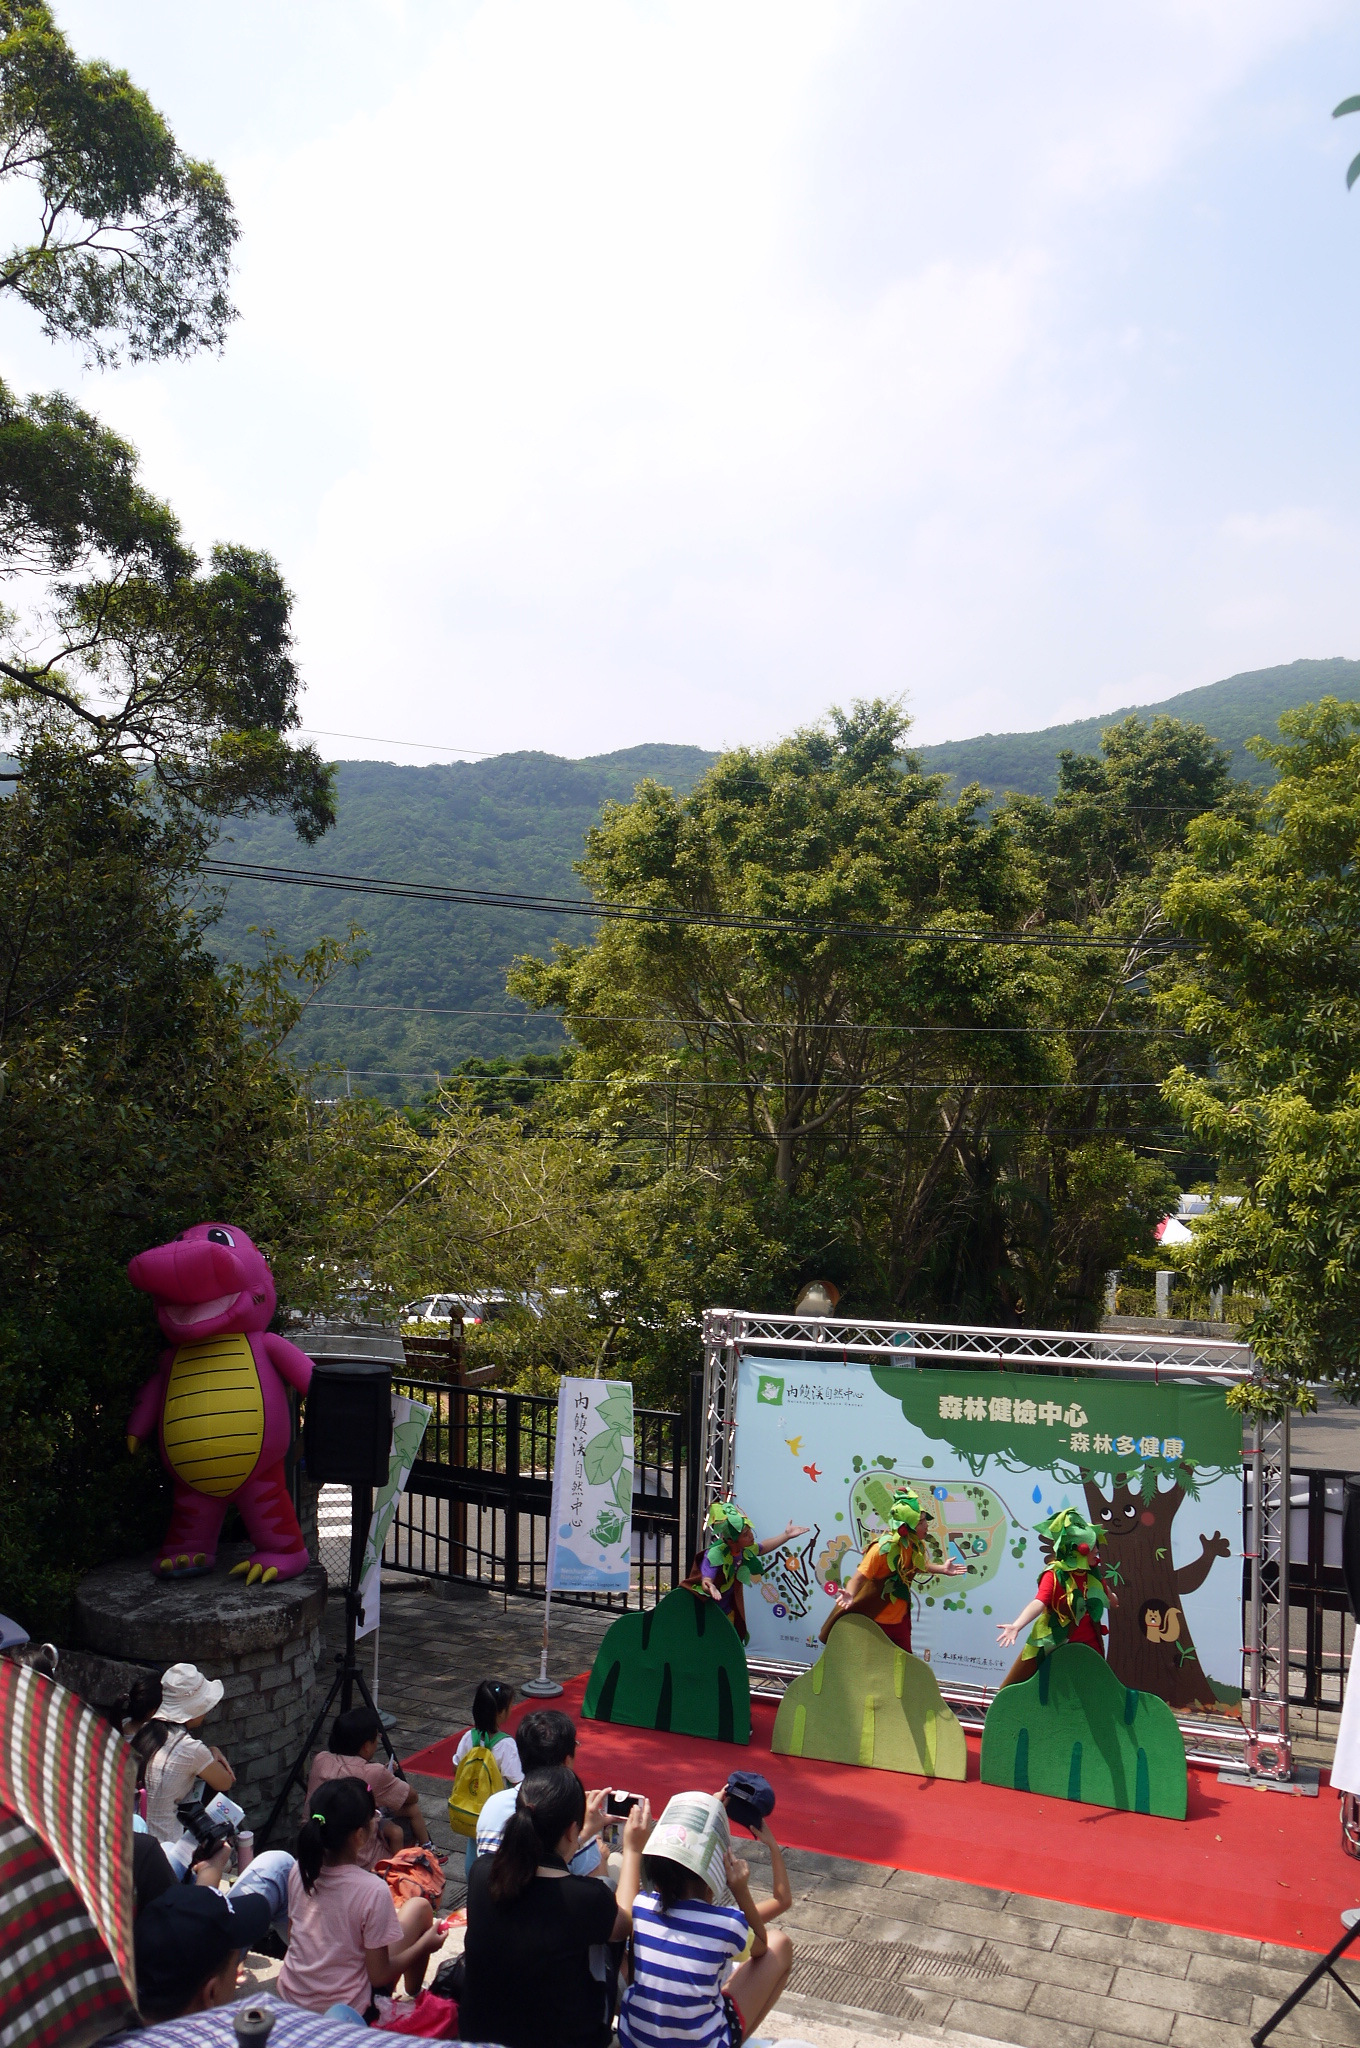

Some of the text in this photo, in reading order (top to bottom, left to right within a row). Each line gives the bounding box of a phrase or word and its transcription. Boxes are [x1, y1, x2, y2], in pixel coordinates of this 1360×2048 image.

[938, 1395, 1089, 1428] 森林健檢中心
[937, 1489, 944, 1499] 1
[976, 1541, 984, 1550] 2
[789, 1559, 796, 1568] 4
[828, 1583, 835, 1593] 3
[776, 1606, 782, 1616] 5
